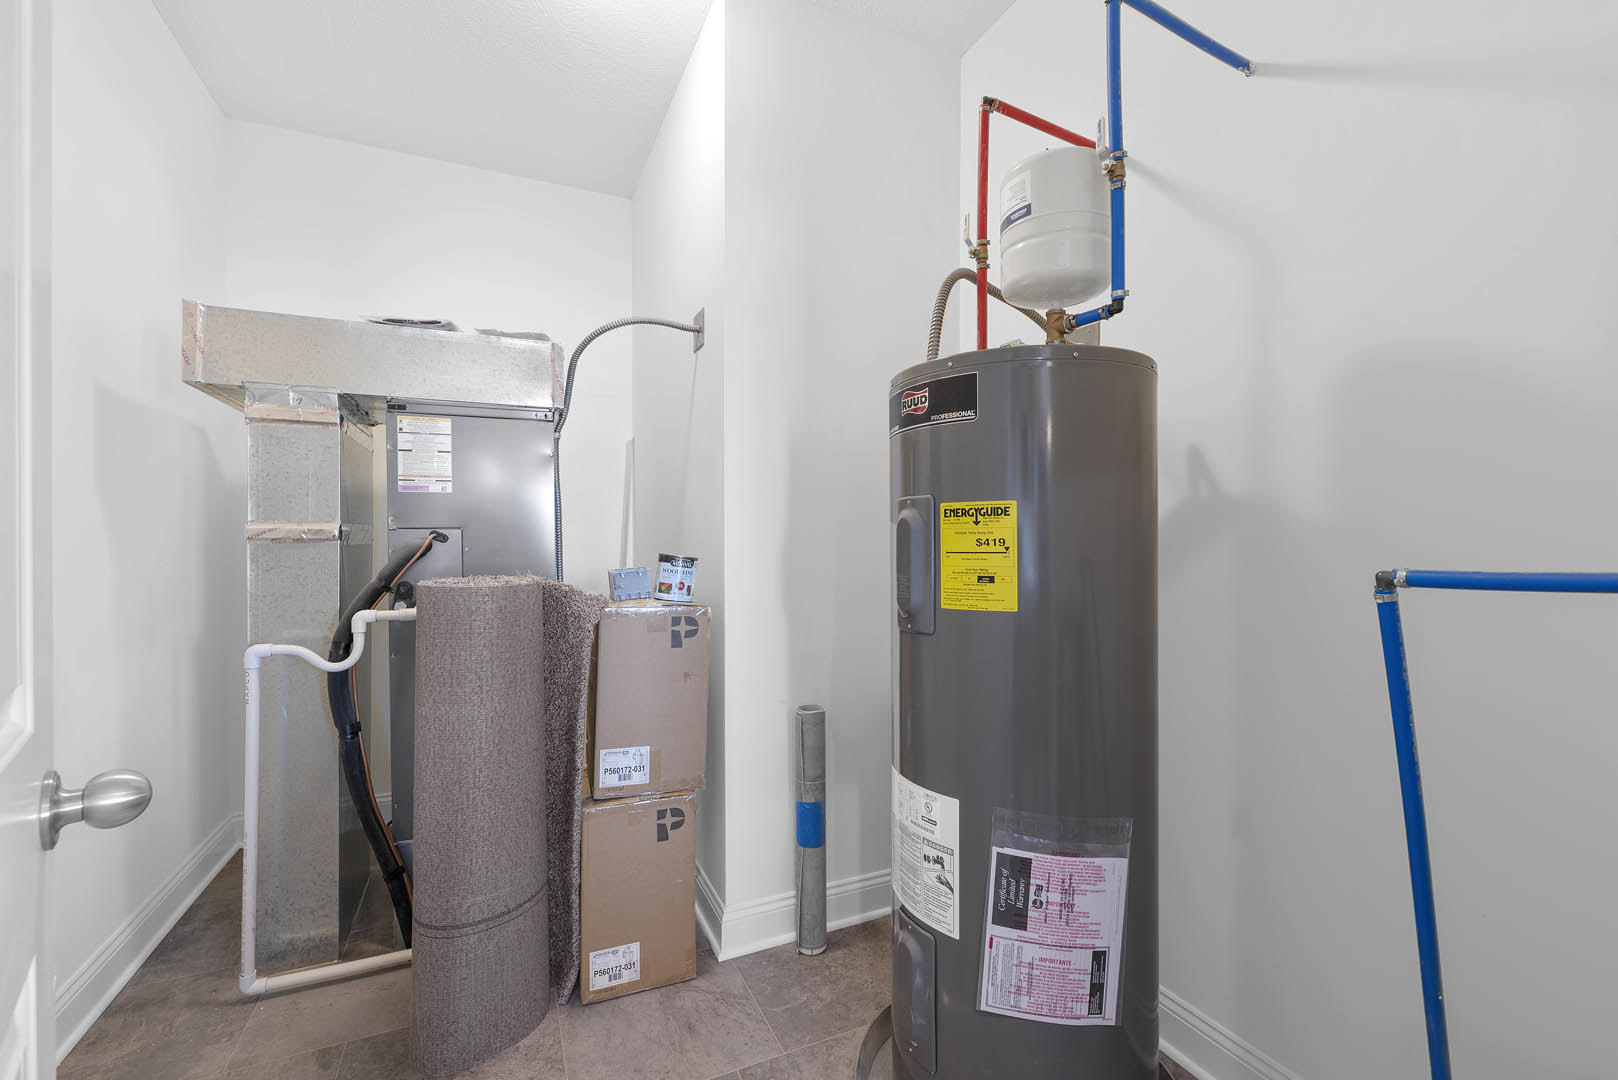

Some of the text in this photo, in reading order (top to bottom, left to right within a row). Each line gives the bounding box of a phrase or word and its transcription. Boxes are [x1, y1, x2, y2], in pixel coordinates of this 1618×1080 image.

[902, 394, 928, 411] RUUD
[930, 409, 976, 421] PROFESSIONAL
[943, 506, 1011, 519] ENERGYGUIDE
[975, 537, 1006, 548] $419
[604, 765, 645, 776] P560172-031
[998, 867, 1010, 911] Certificate of
[1008, 879, 1017, 905] Limited
[1016, 879, 1026, 909] Warranty
[593, 961, 636, 978] P560172-031
